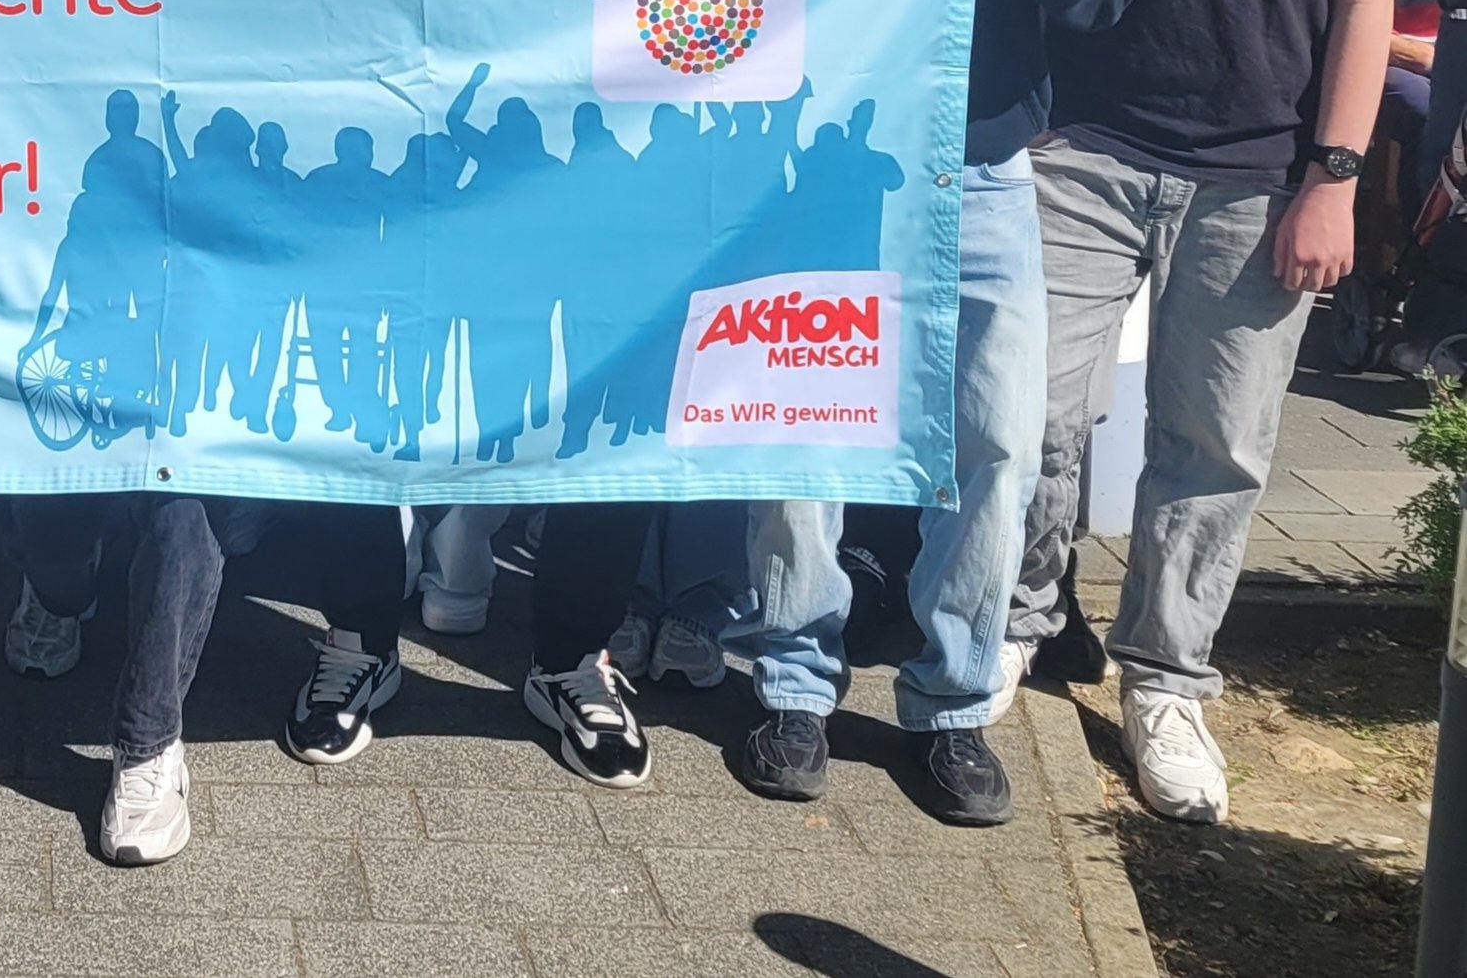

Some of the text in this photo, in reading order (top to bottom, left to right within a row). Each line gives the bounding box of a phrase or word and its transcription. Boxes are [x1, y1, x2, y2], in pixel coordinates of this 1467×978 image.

[766, 345, 880, 369] MENSCH
[683, 402, 878, 426] Das WIR gewinnt
